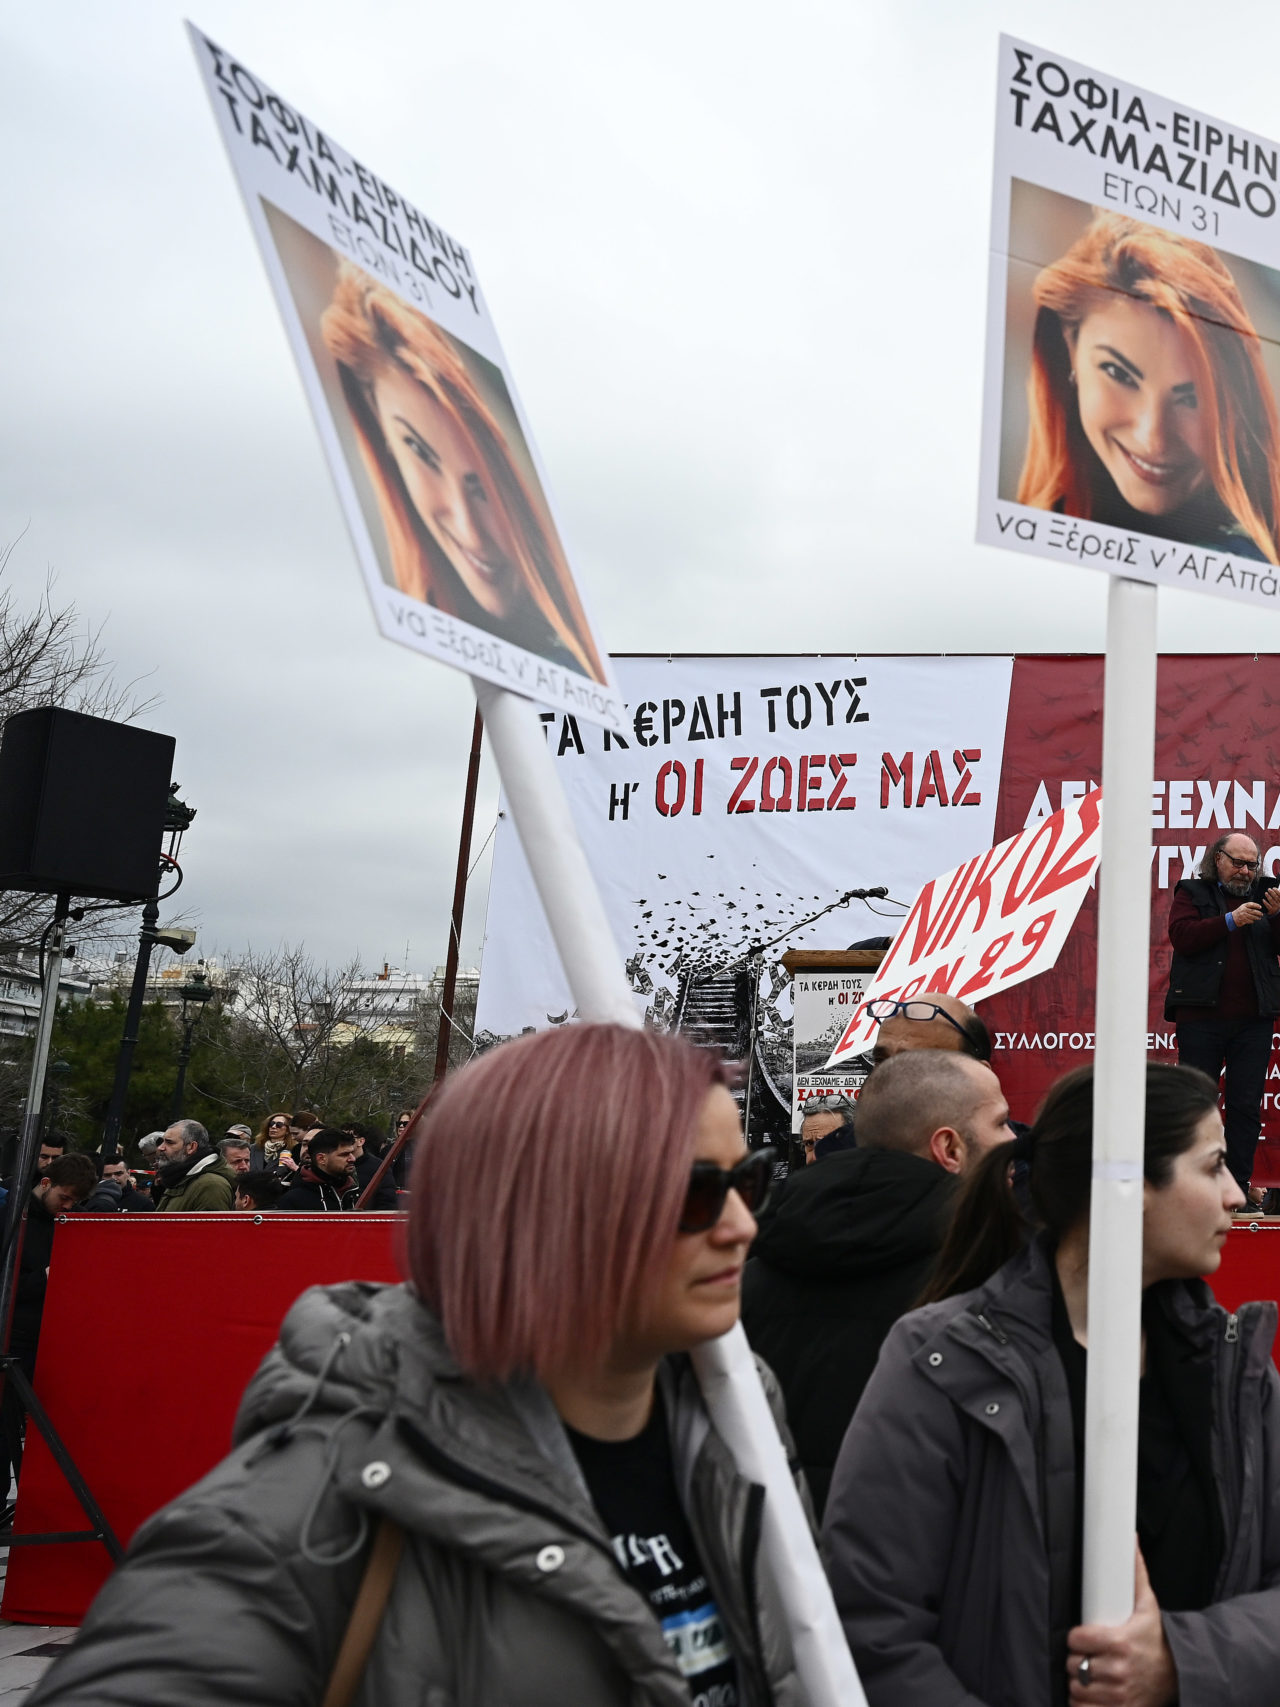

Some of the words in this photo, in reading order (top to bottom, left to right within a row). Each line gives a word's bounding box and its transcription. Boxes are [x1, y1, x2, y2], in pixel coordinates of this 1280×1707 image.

[203, 36, 472, 278] ΣΟΦΙΑ-ΕΙΡΗΝΗ
[218, 85, 480, 315] ΤΑΧΜΑΖΙΔΟΥ
[1103, 172, 1182, 222] ΕΤΩΝ
[1191, 204, 1220, 236] 31
[996, 512, 1037, 541] να
[760, 677, 870, 733] ΤΟΥΣ
[655, 757, 703, 818] ΟΙ
[727, 752, 858, 815] ΖΩΕΣ
[880, 748, 983, 809] ΜΑΣ
[1023, 779, 1100, 830] ΔΕ
[877, 785, 1103, 983] ΝΙΚΟΣ
[956, 909, 1057, 999] 29
[799, 981, 809, 992] ΤΑ
[841, 979, 862, 990] ΤΟΥΣ
[838, 992, 848, 1005] ΟΙ
[994, 1032, 1095, 1050] ΣΥΛΛΟΓΟΣ
